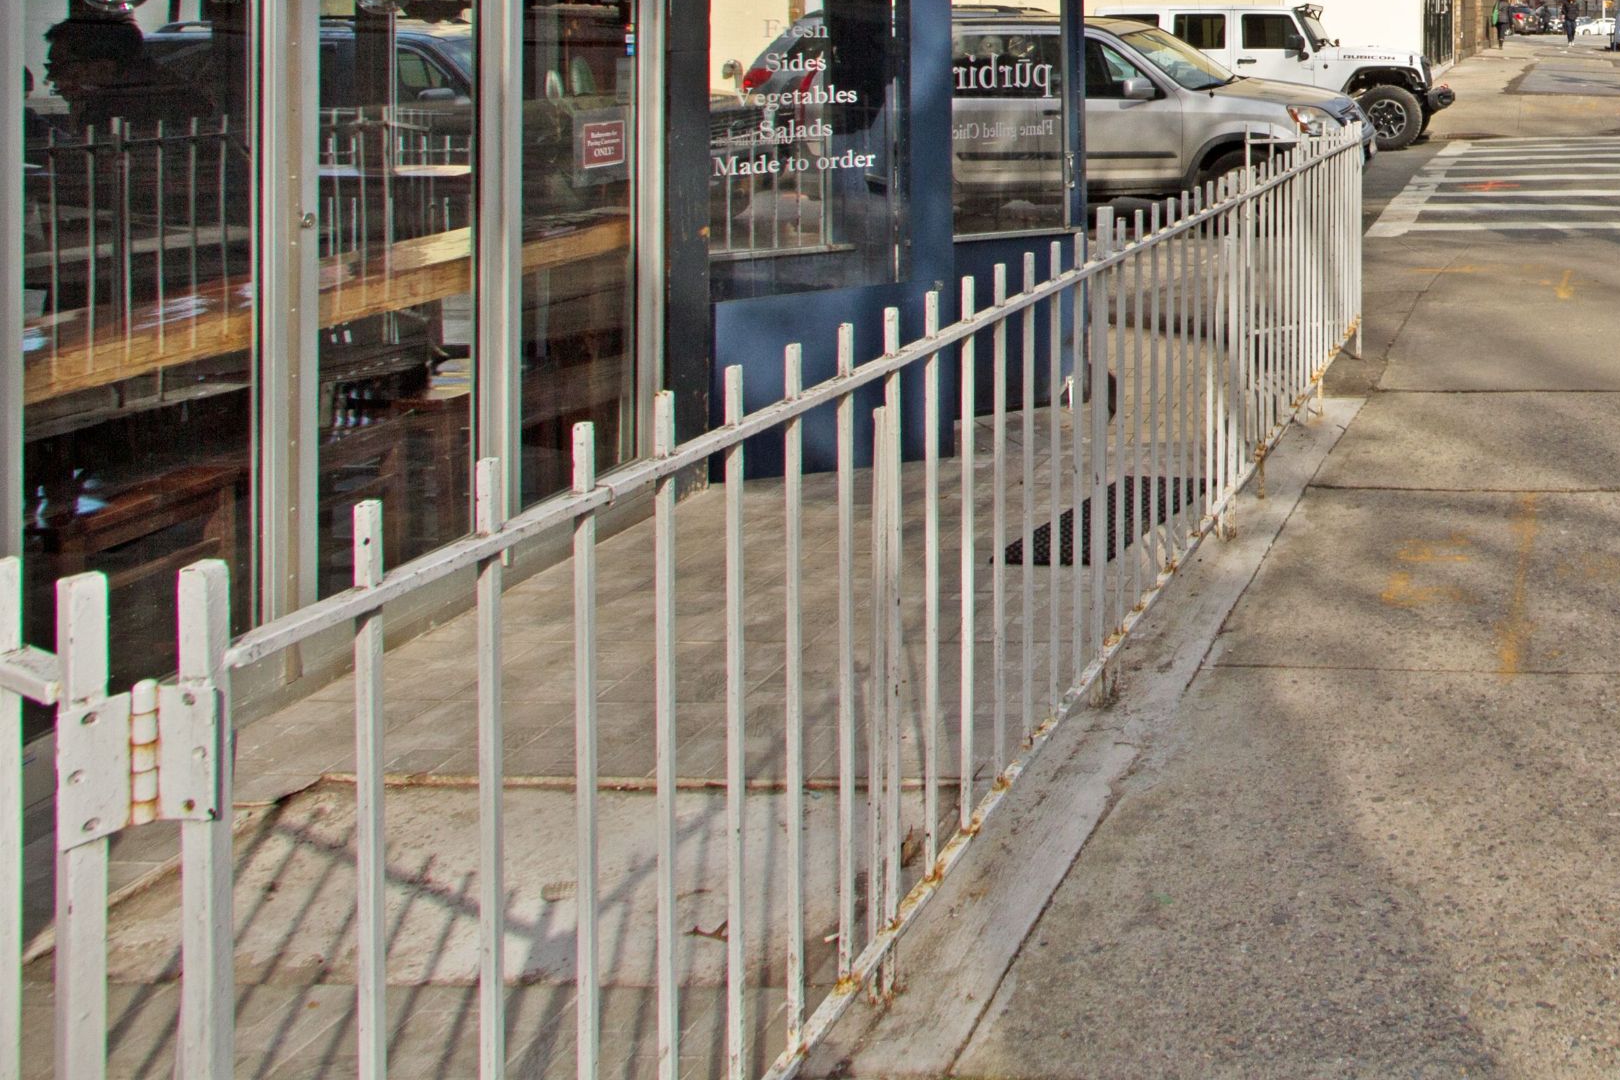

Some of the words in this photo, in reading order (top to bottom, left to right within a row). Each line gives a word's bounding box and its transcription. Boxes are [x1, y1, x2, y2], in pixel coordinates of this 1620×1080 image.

[763, 19, 829, 38] Fresh
[765, 52, 827, 72] Sides
[735, 84, 858, 112] Vegetables
[759, 118, 833, 140] Salads
[713, 155, 780, 177] Made
[786, 157, 810, 171] to
[816, 149, 876, 170] order
